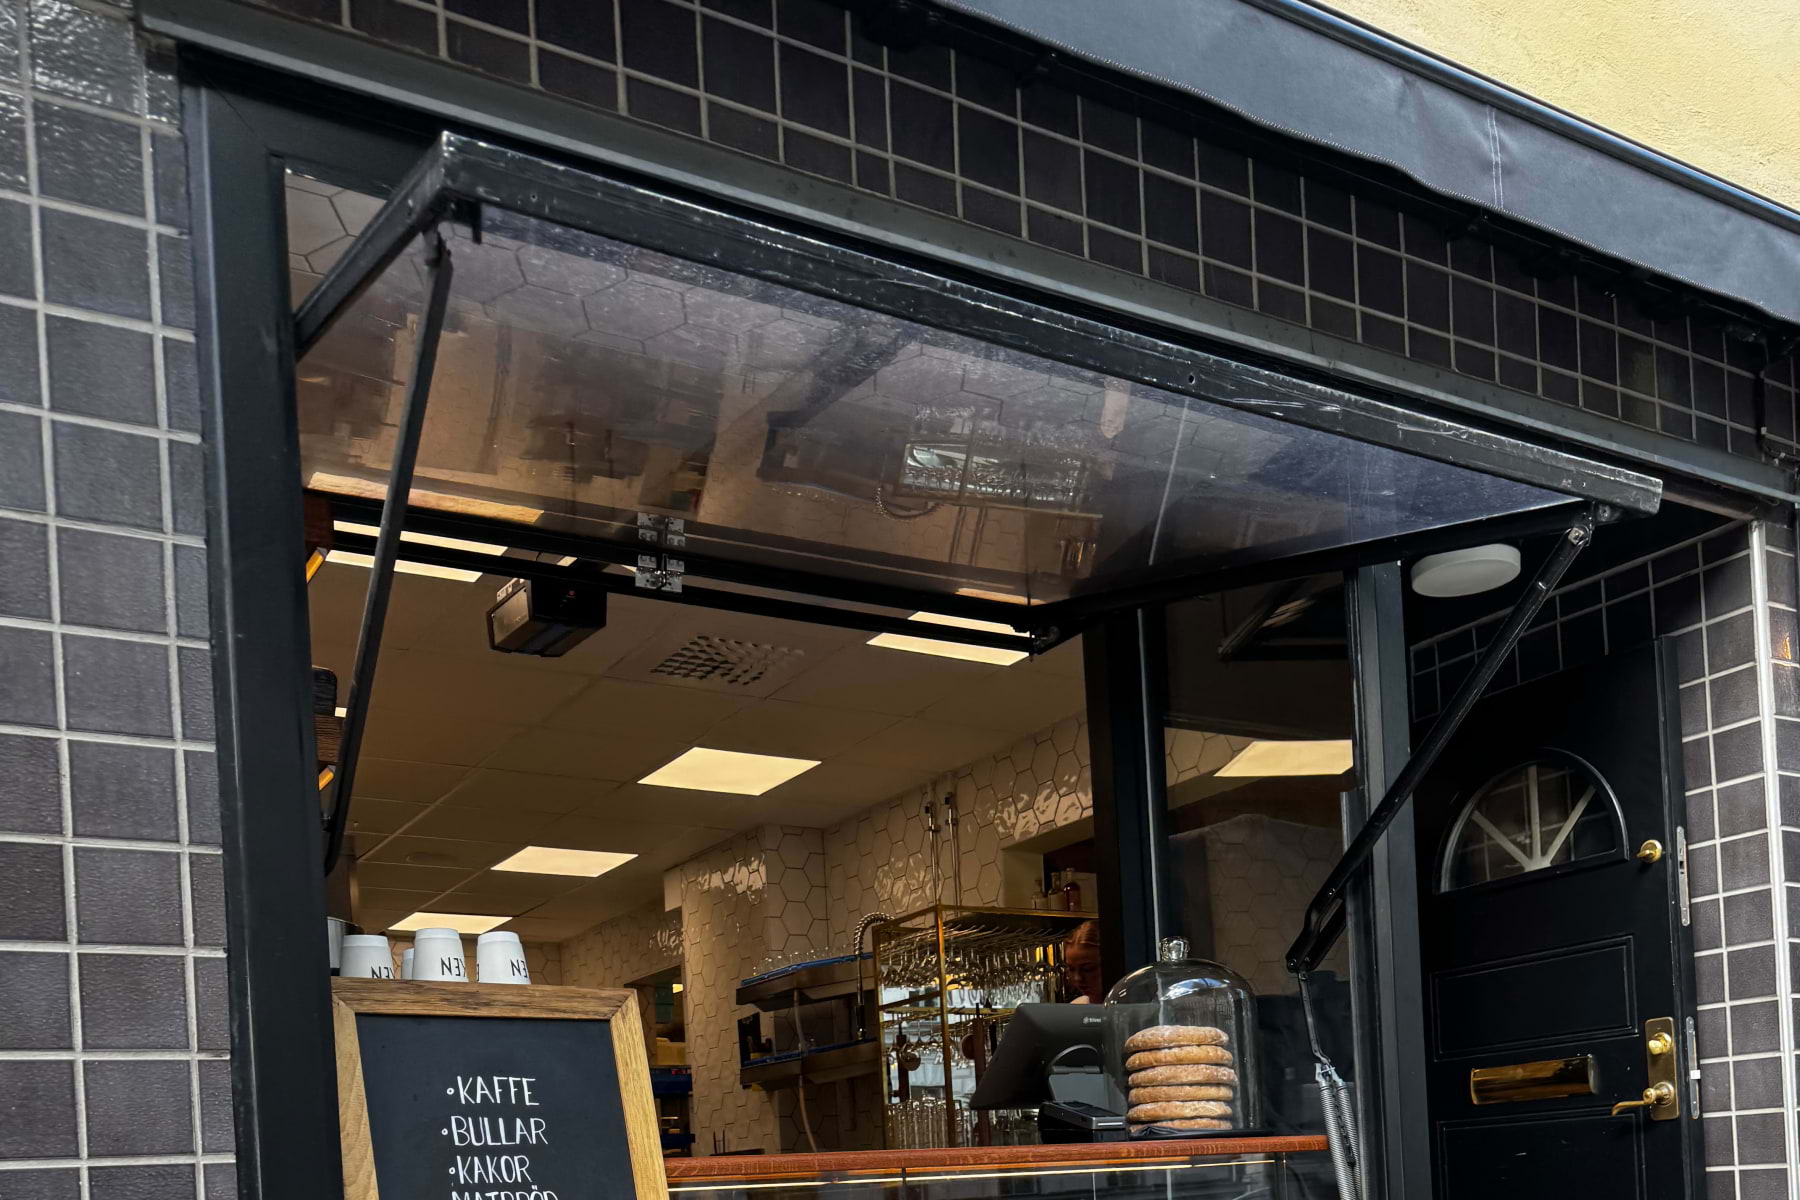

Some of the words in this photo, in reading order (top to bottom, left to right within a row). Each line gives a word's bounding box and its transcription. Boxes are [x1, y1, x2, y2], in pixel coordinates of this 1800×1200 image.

[440, 957, 466, 977] KEN
[457, 1075, 540, 1106] KAFFE
[450, 1115, 548, 1146] BULLAR
[456, 1154, 533, 1184] KAKOR
